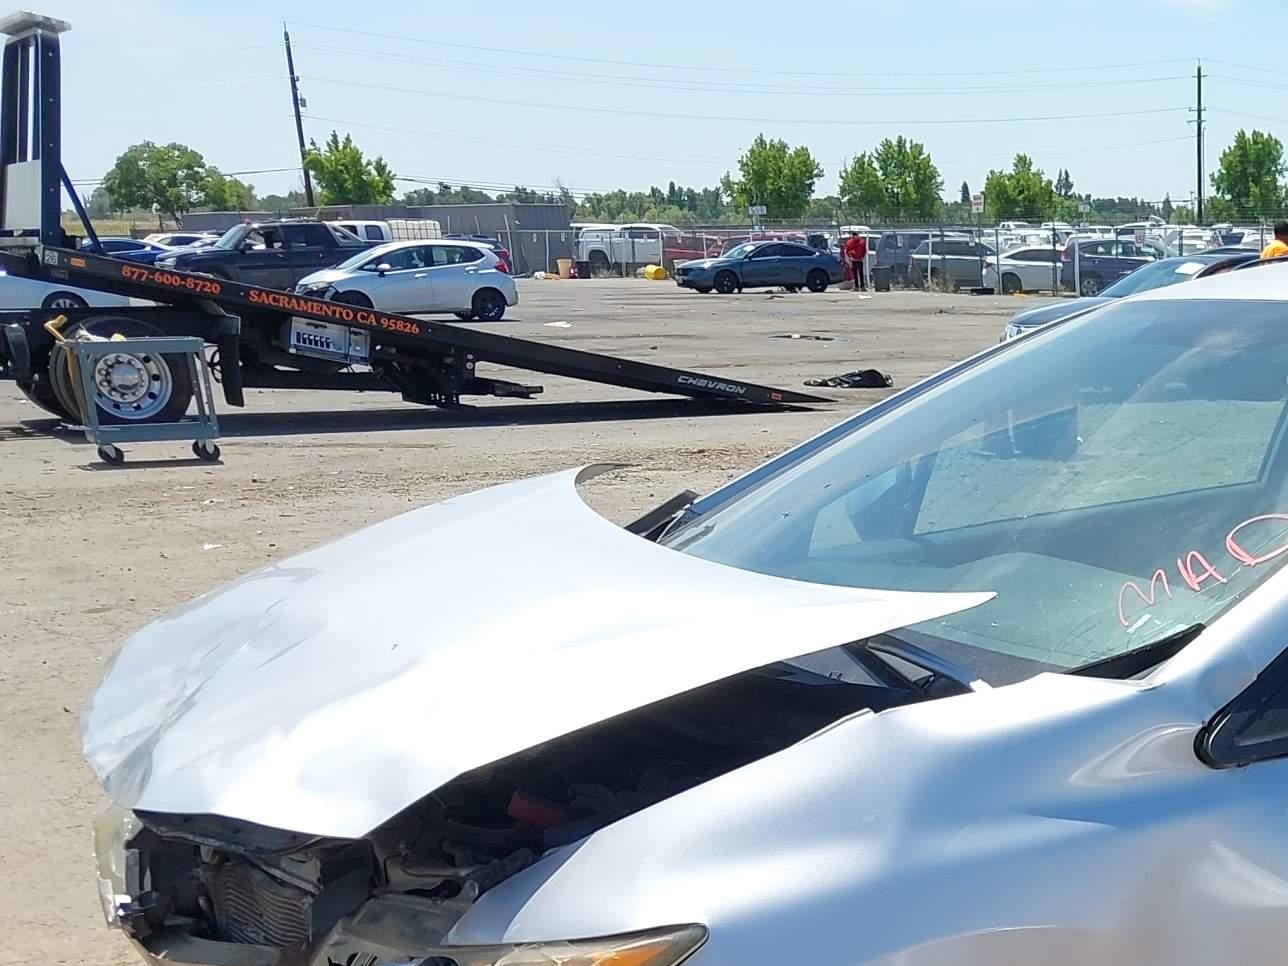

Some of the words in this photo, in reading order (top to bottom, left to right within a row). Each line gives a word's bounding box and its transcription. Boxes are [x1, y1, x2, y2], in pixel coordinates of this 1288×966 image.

[120, 265, 221, 295] 877-600-8720
[249, 289, 354, 321] SACRAMENTO
[356, 311, 377, 326] CA
[380, 318, 420, 335] 95826
[677, 375, 747, 394] CHEVRON
